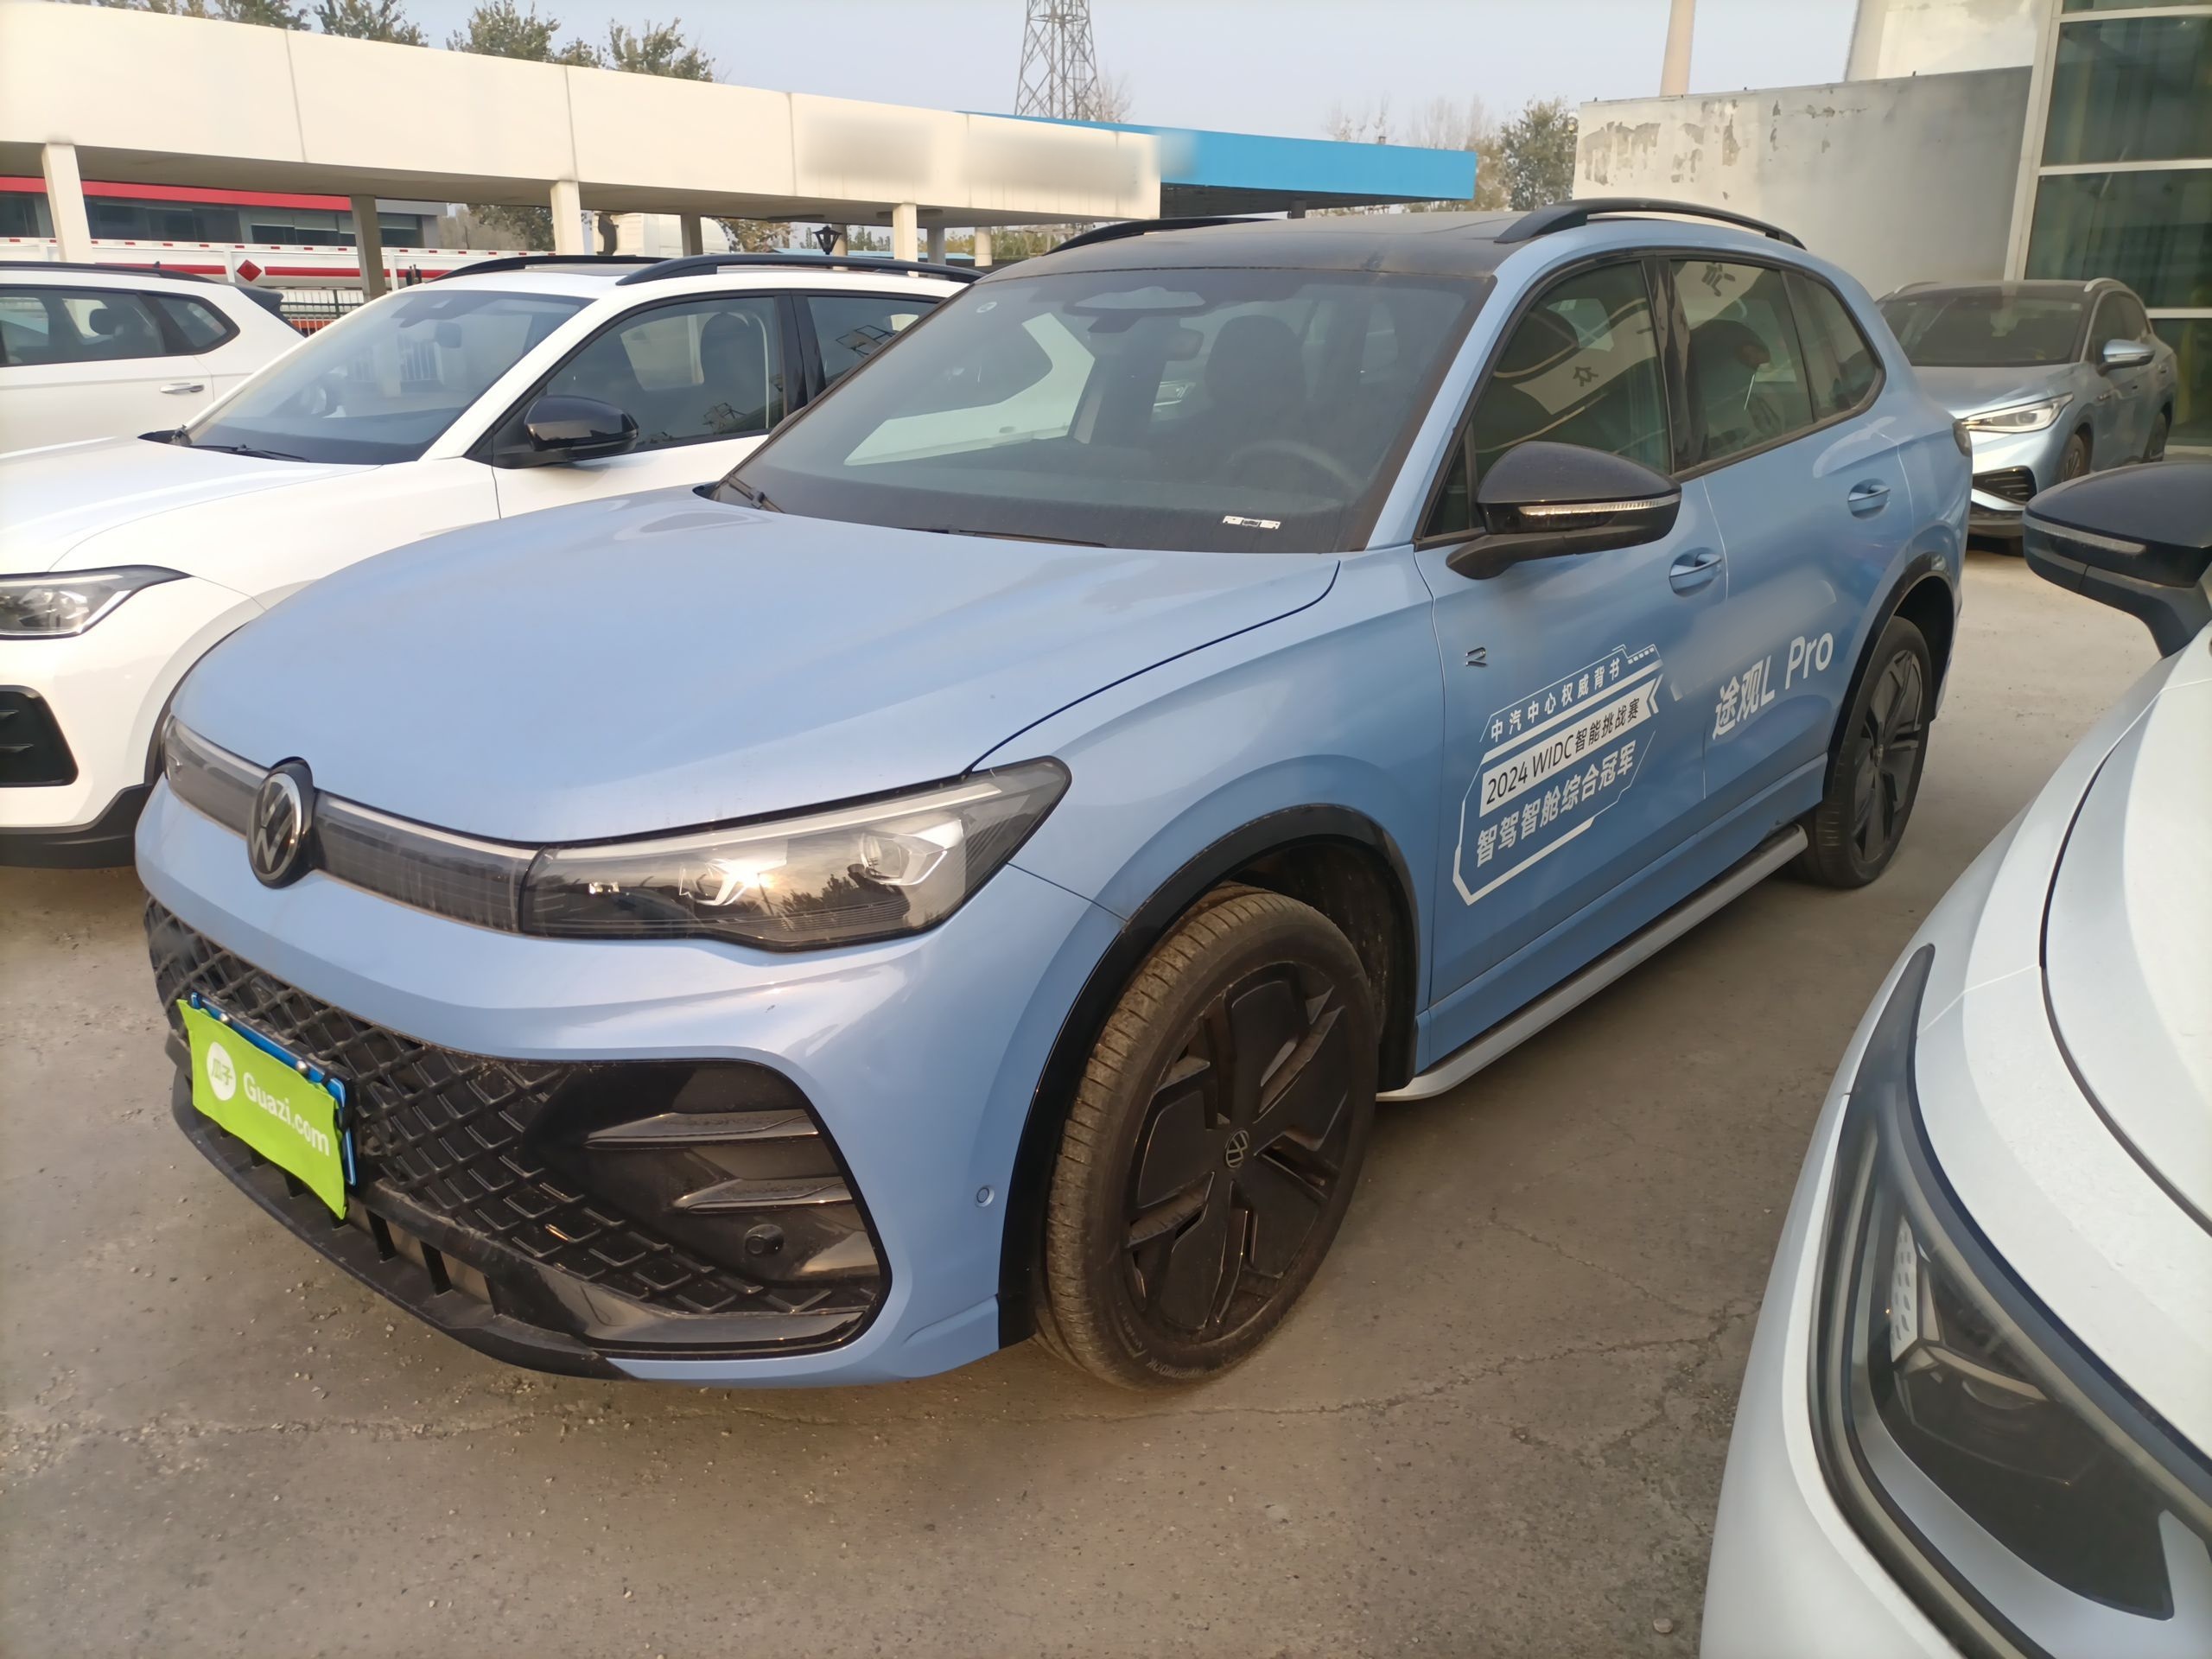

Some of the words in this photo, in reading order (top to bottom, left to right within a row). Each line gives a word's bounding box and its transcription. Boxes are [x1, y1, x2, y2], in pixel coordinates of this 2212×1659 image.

[1491, 658, 1621, 743] 中汽中心权威背书
[1712, 655, 1776, 741] 途观L
[1784, 632, 1834, 690] Pro
[1477, 740, 1637, 868] 智驾智舱综合冠军
[1486, 760, 1528, 804] 2024
[1532, 697, 1640, 778] WIDC智能挑战赛
[243, 1071, 330, 1157] Guazi.com
